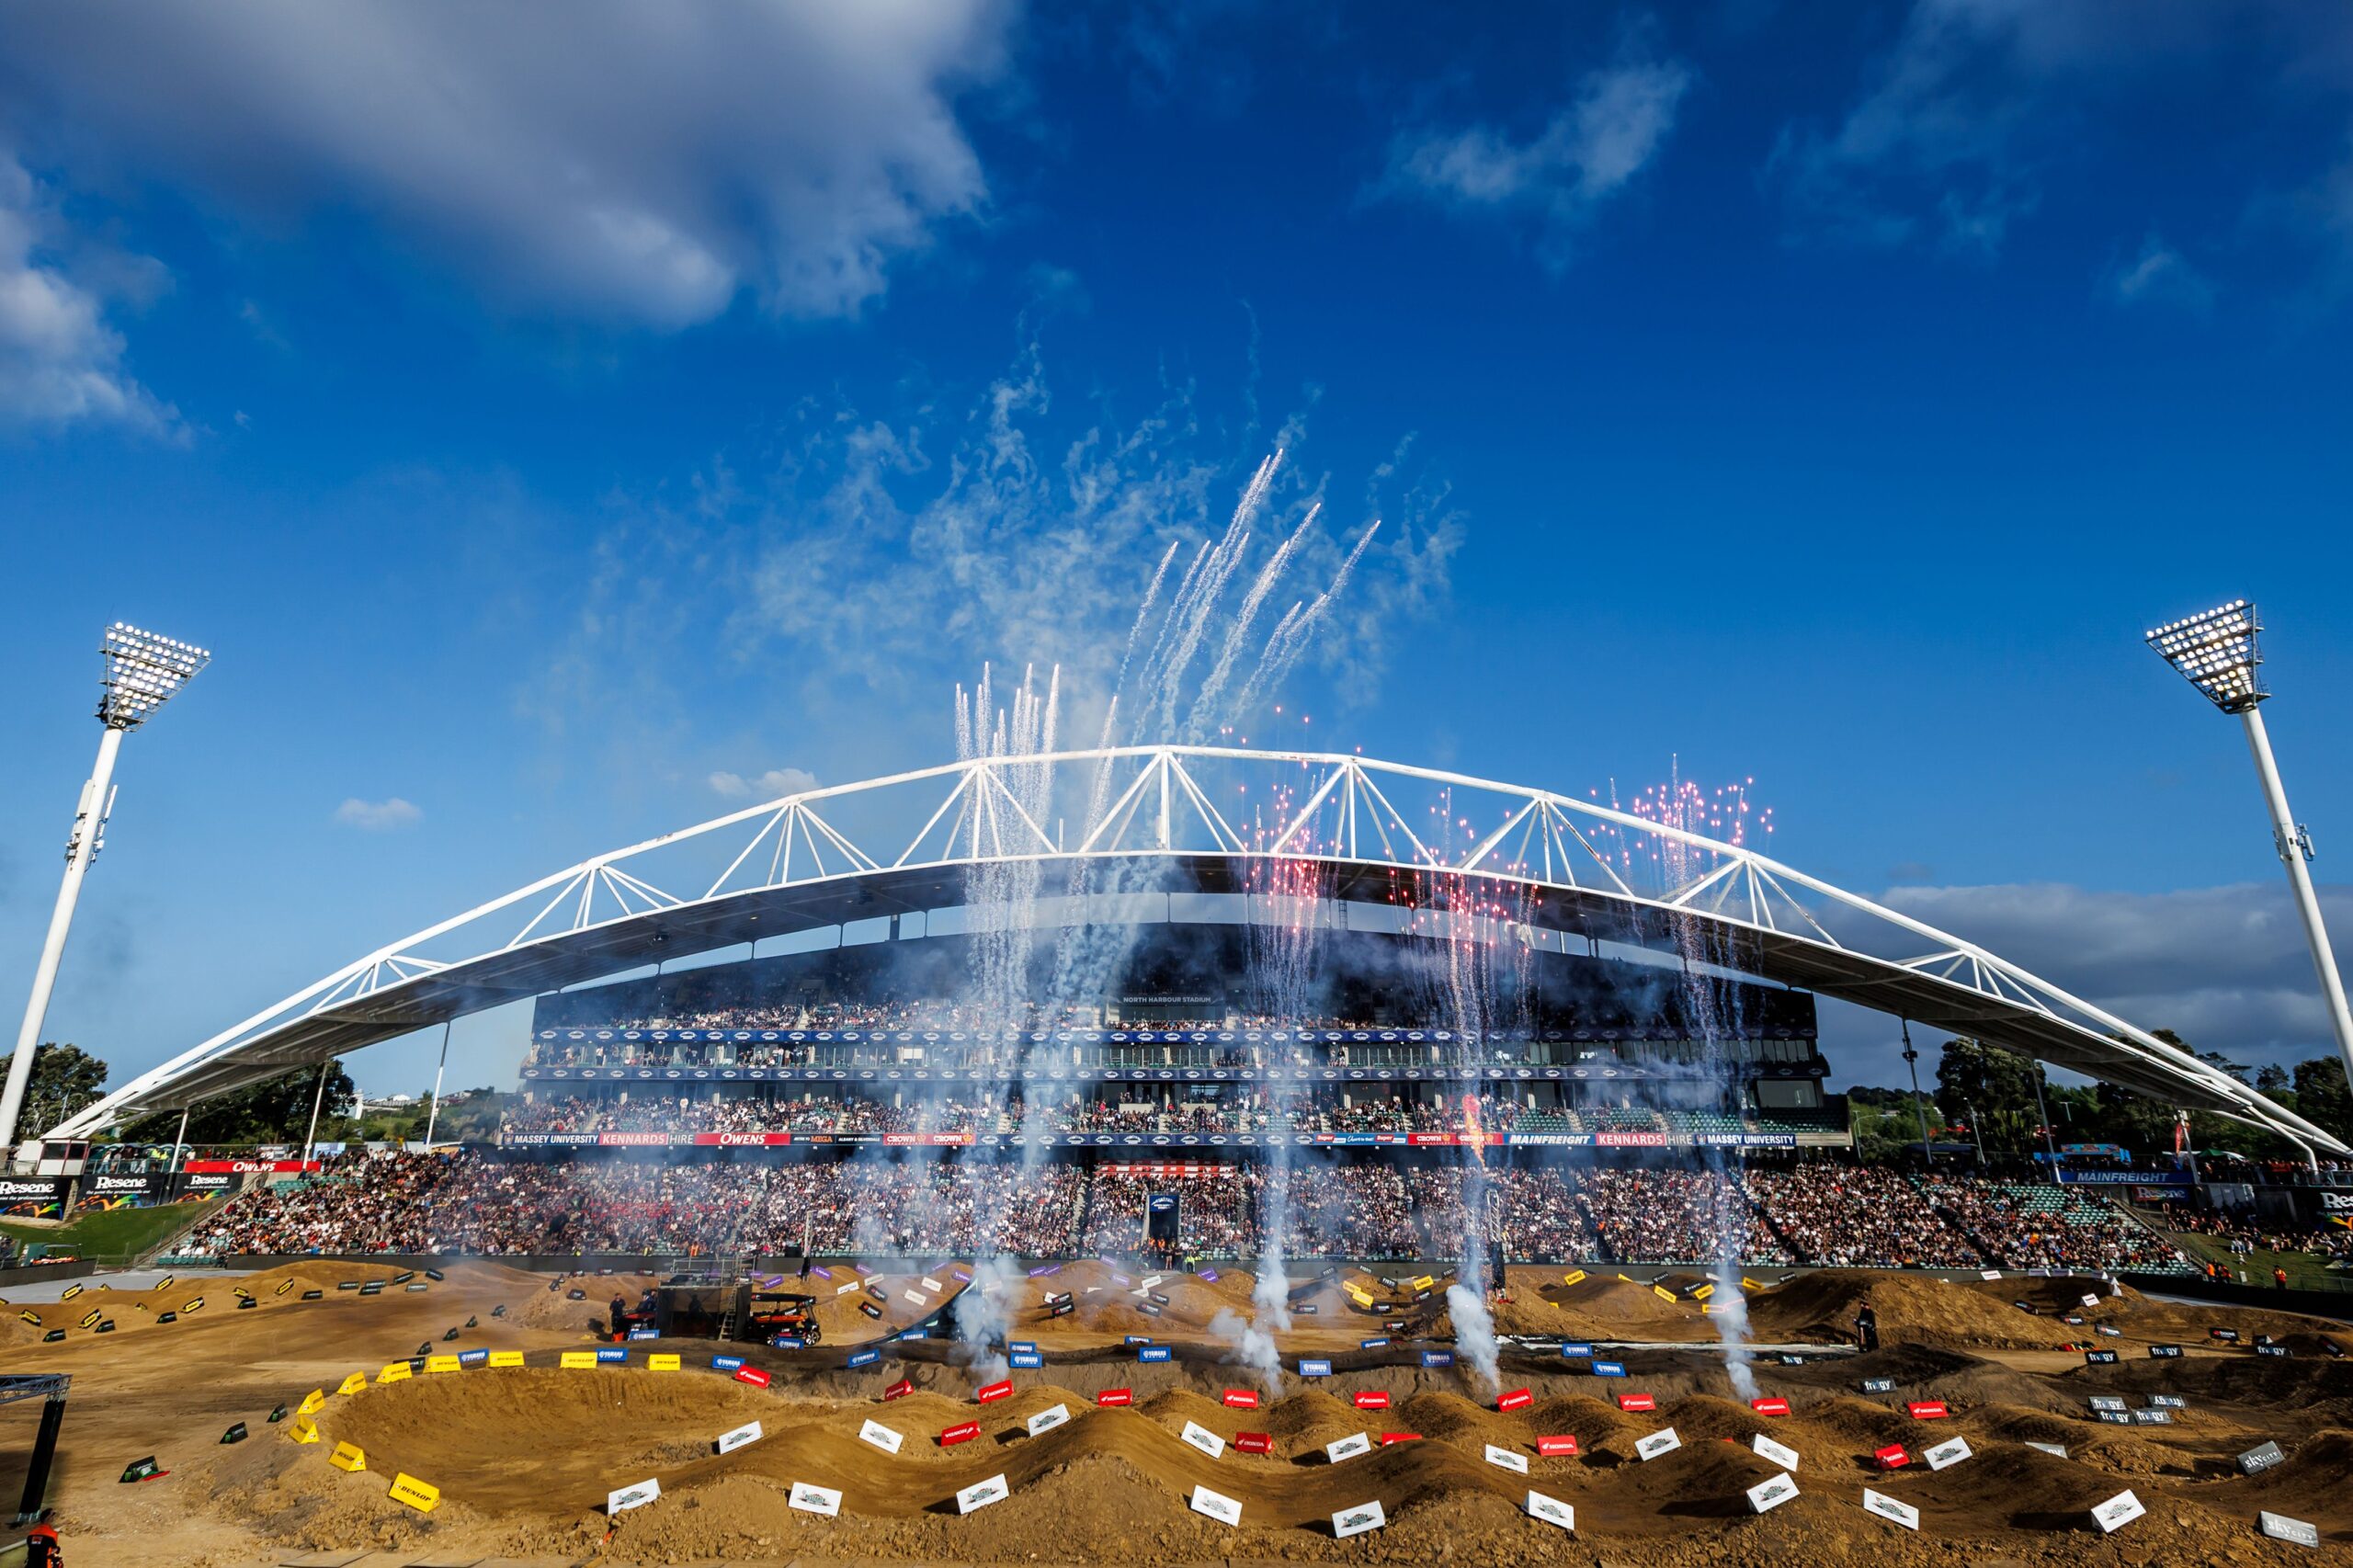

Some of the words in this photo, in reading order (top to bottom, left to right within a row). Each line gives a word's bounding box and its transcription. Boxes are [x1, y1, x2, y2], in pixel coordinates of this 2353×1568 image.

[514, 1134, 551, 1144] MASSEY
[551, 1134, 598, 1144] UNIVERSITY
[602, 1134, 665, 1144] KENNARDS
[669, 1135, 694, 1144] HIRE
[720, 1132, 766, 1144] OWENS
[1509, 1134, 1590, 1144] MAINFREIGHT
[1598, 1134, 1663, 1145] KENNARDS
[1667, 1135, 1693, 1145] HIRE
[1707, 1134, 1743, 1144] MASSEY
[1744, 1134, 1794, 1144] UNIVERSITY
[95, 1176, 147, 1189] Resene
[190, 1175, 229, 1186] Resene
[2077, 1172, 2169, 1183] MAINFREIGHT
[0, 1181, 55, 1194] Resene
[2137, 1187, 2186, 1199] Resene
[1864, 1380, 1891, 1391] fridgy
[988, 1387, 1009, 1396] HONDA
[1507, 1395, 1529, 1404] HONDA
[2099, 1411, 2129, 1423] fridgy
[2136, 1411, 2164, 1422] fridgy
[401, 1485, 432, 1503] DUNLOP
